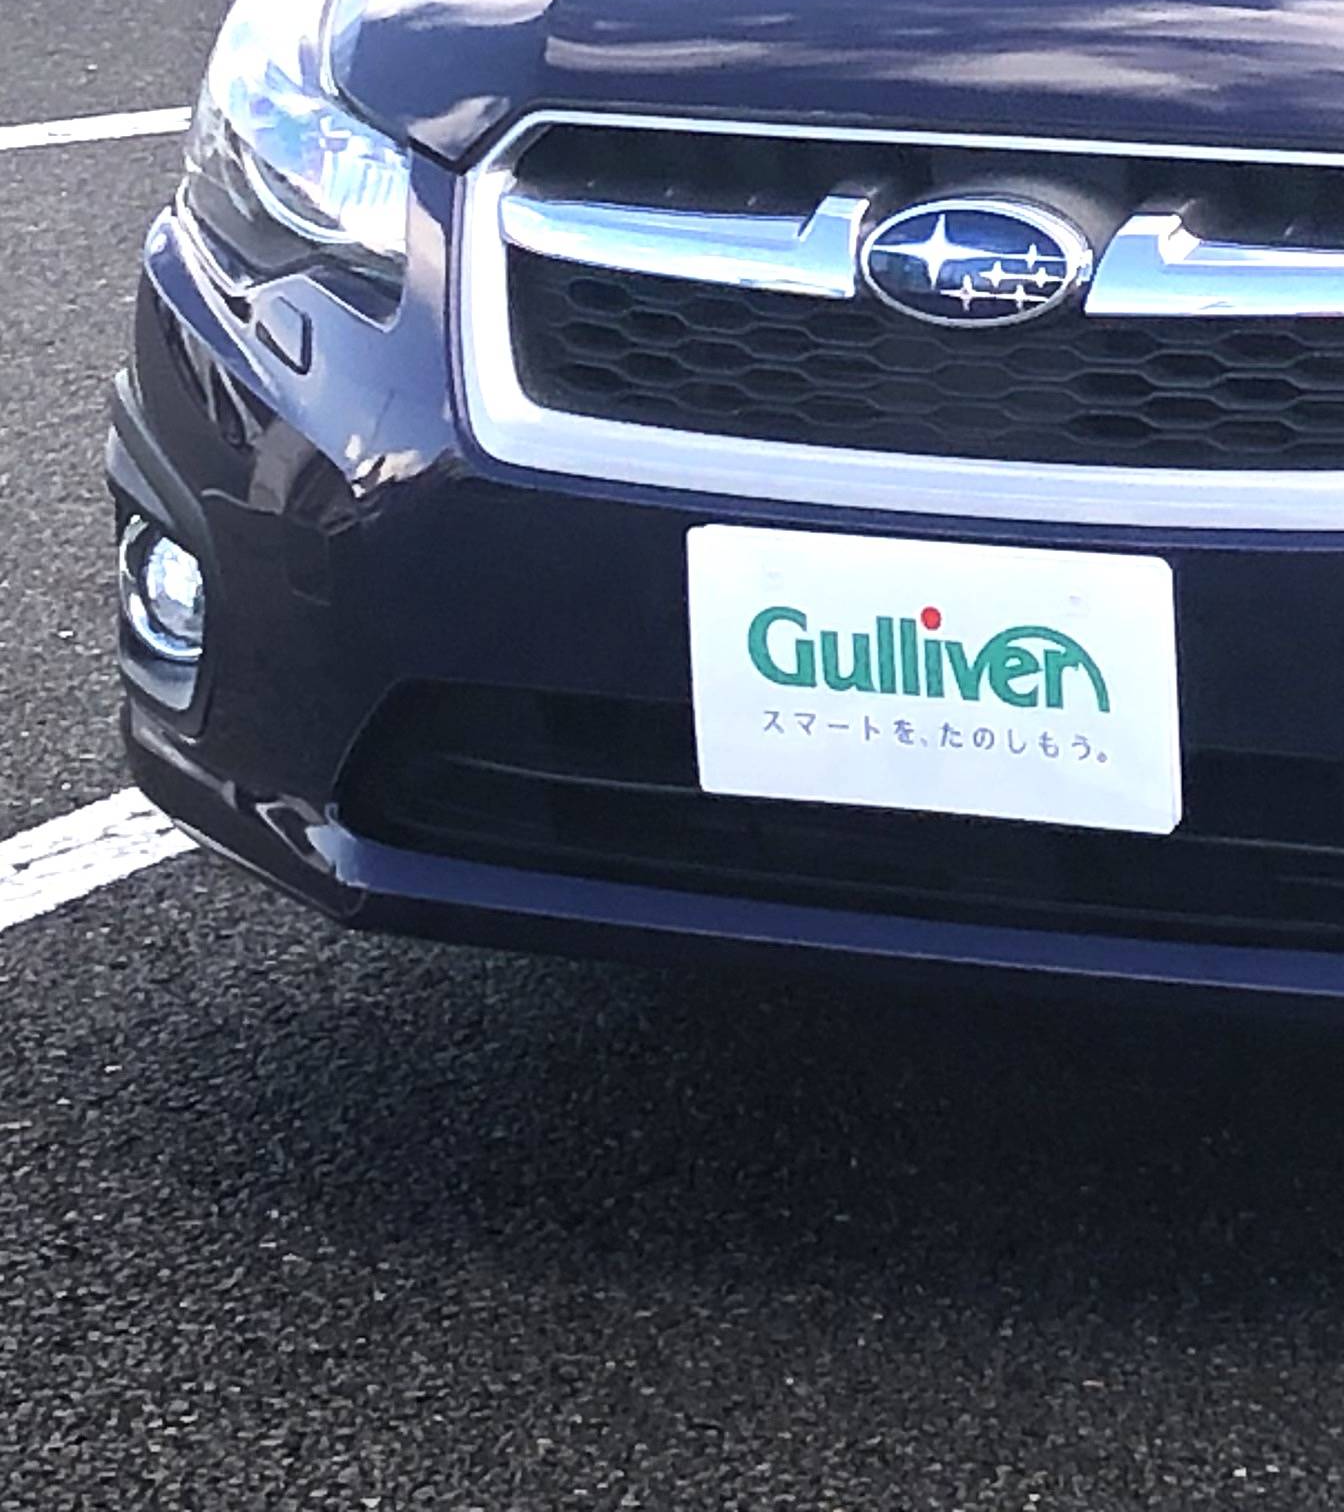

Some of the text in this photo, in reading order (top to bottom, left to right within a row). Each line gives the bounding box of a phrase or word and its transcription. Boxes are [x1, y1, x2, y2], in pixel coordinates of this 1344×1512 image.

[747, 605, 1111, 713] Gulliver
[762, 710, 1109, 764] スマートを、たのしもう。
